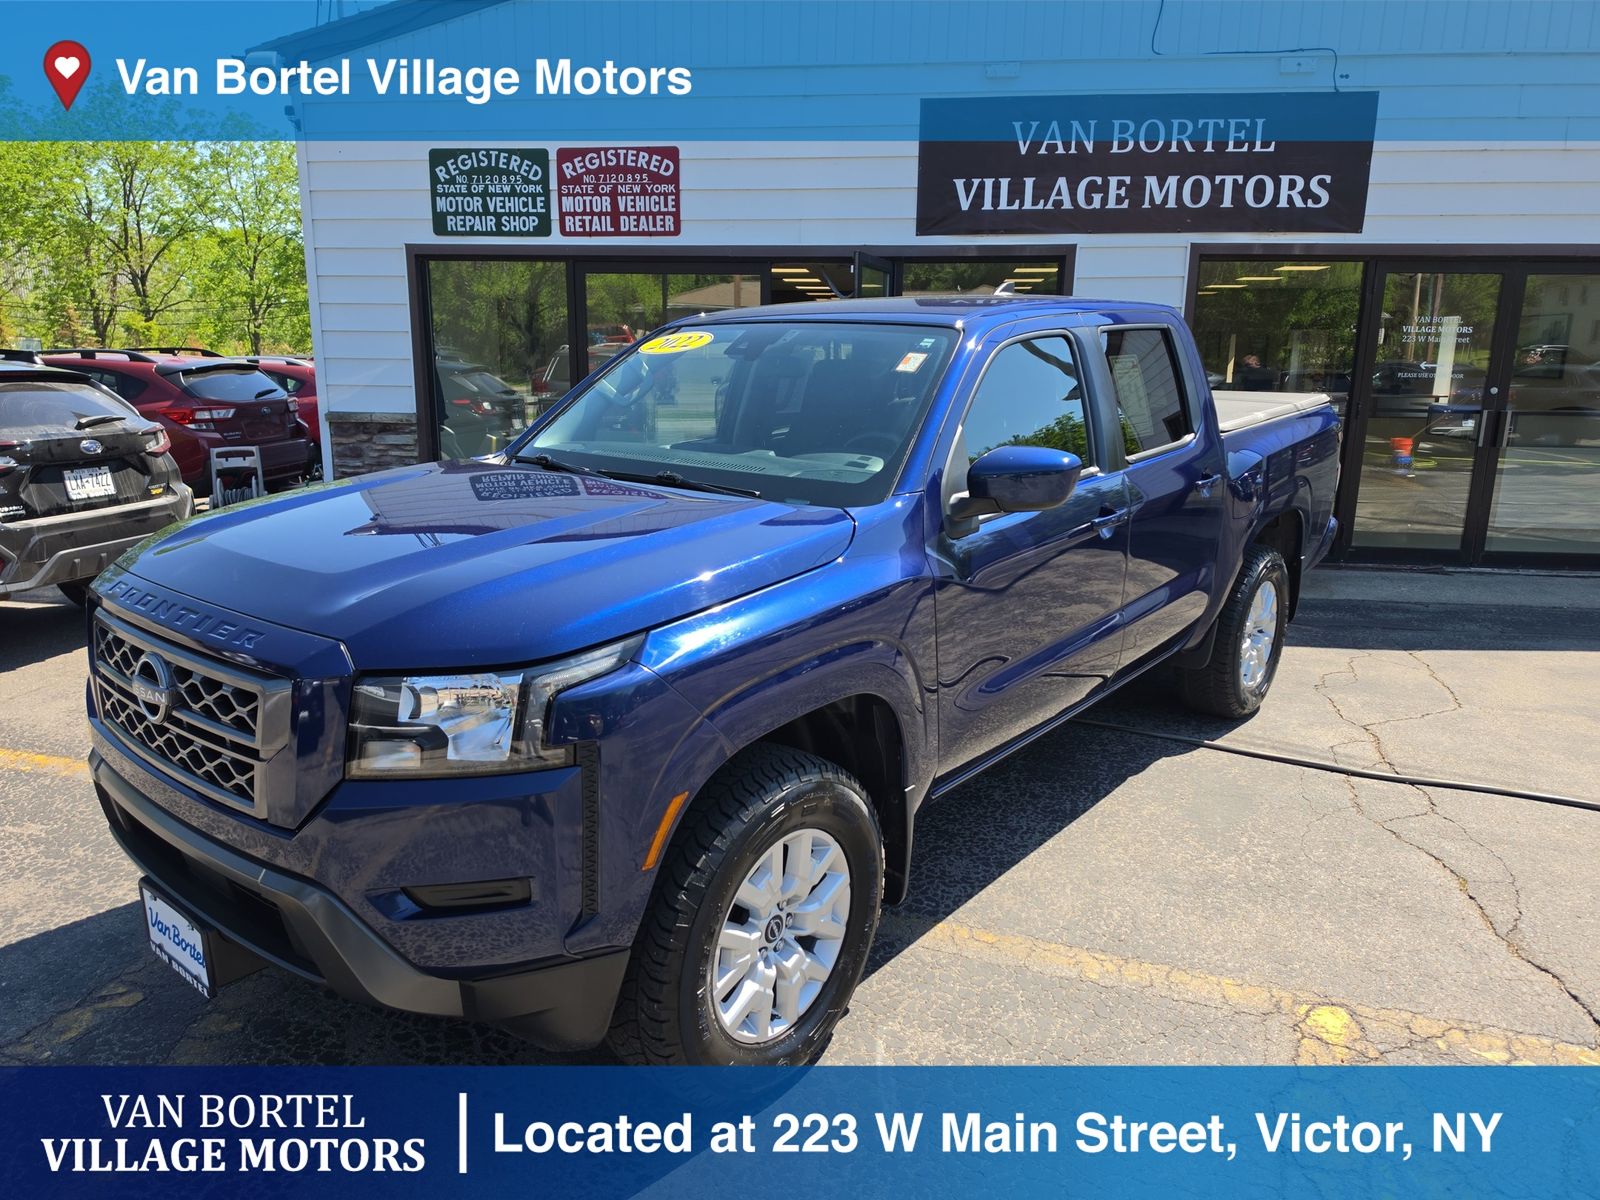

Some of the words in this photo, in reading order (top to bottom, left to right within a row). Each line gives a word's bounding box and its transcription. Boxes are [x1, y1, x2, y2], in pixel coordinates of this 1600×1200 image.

[1012, 120, 1098, 155] VAN
[1110, 118, 1276, 153] BORTEL
[435, 151, 542, 182] REGISTERED
[562, 149, 675, 179] REGISTERED
[456, 176, 469, 184] NO.
[471, 175, 523, 184] 7120895
[583, 175, 597, 184] NO.
[598, 174, 649, 183] 7120895
[436, 185, 468, 193] STATE
[471, 185, 484, 193] OF
[488, 185, 512, 193] NEW
[514, 185, 543, 193] YORK
[561, 185, 594, 194] STATE
[599, 185, 612, 194] OF
[617, 185, 641, 194] NEW
[645, 184, 676, 193] YORK
[953, 176, 1131, 211] VILLAGE
[1142, 174, 1332, 208] MOTORS
[436, 197, 483, 213] MOTOR
[485, 197, 546, 213] VEHICLE
[562, 196, 611, 212] MOTOR
[617, 196, 676, 212] VEHICLE
[447, 216, 497, 232] REPAIR
[501, 216, 539, 232] SHOP
[565, 216, 614, 232] RETAIL
[620, 216, 674, 232] DEALER
[108, 581, 266, 648] FRONTIER
